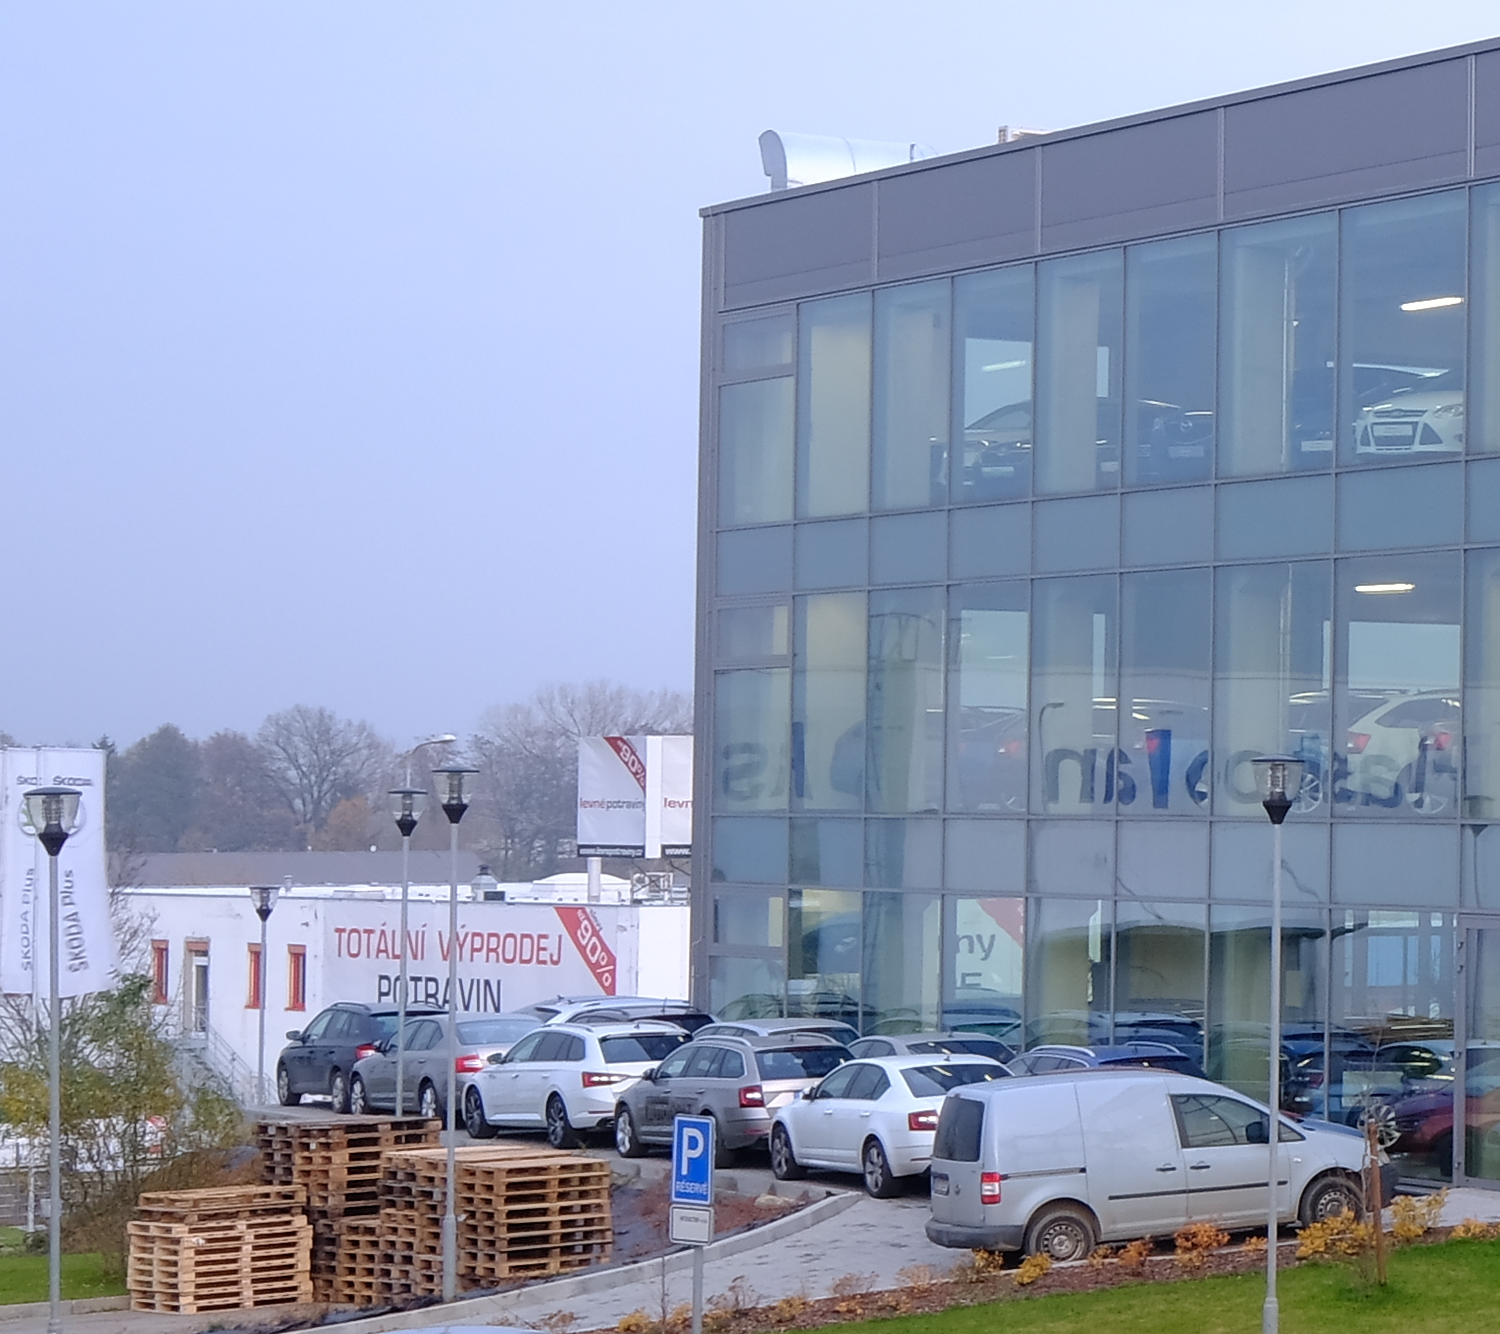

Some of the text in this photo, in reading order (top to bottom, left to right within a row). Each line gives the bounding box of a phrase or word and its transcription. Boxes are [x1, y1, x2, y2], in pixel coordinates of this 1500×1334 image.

[334, 921, 563, 966] TOTÁLNÍ VÝPRODEJ
[577, 919, 614, 987] 90%
[681, 1126, 705, 1176] P
